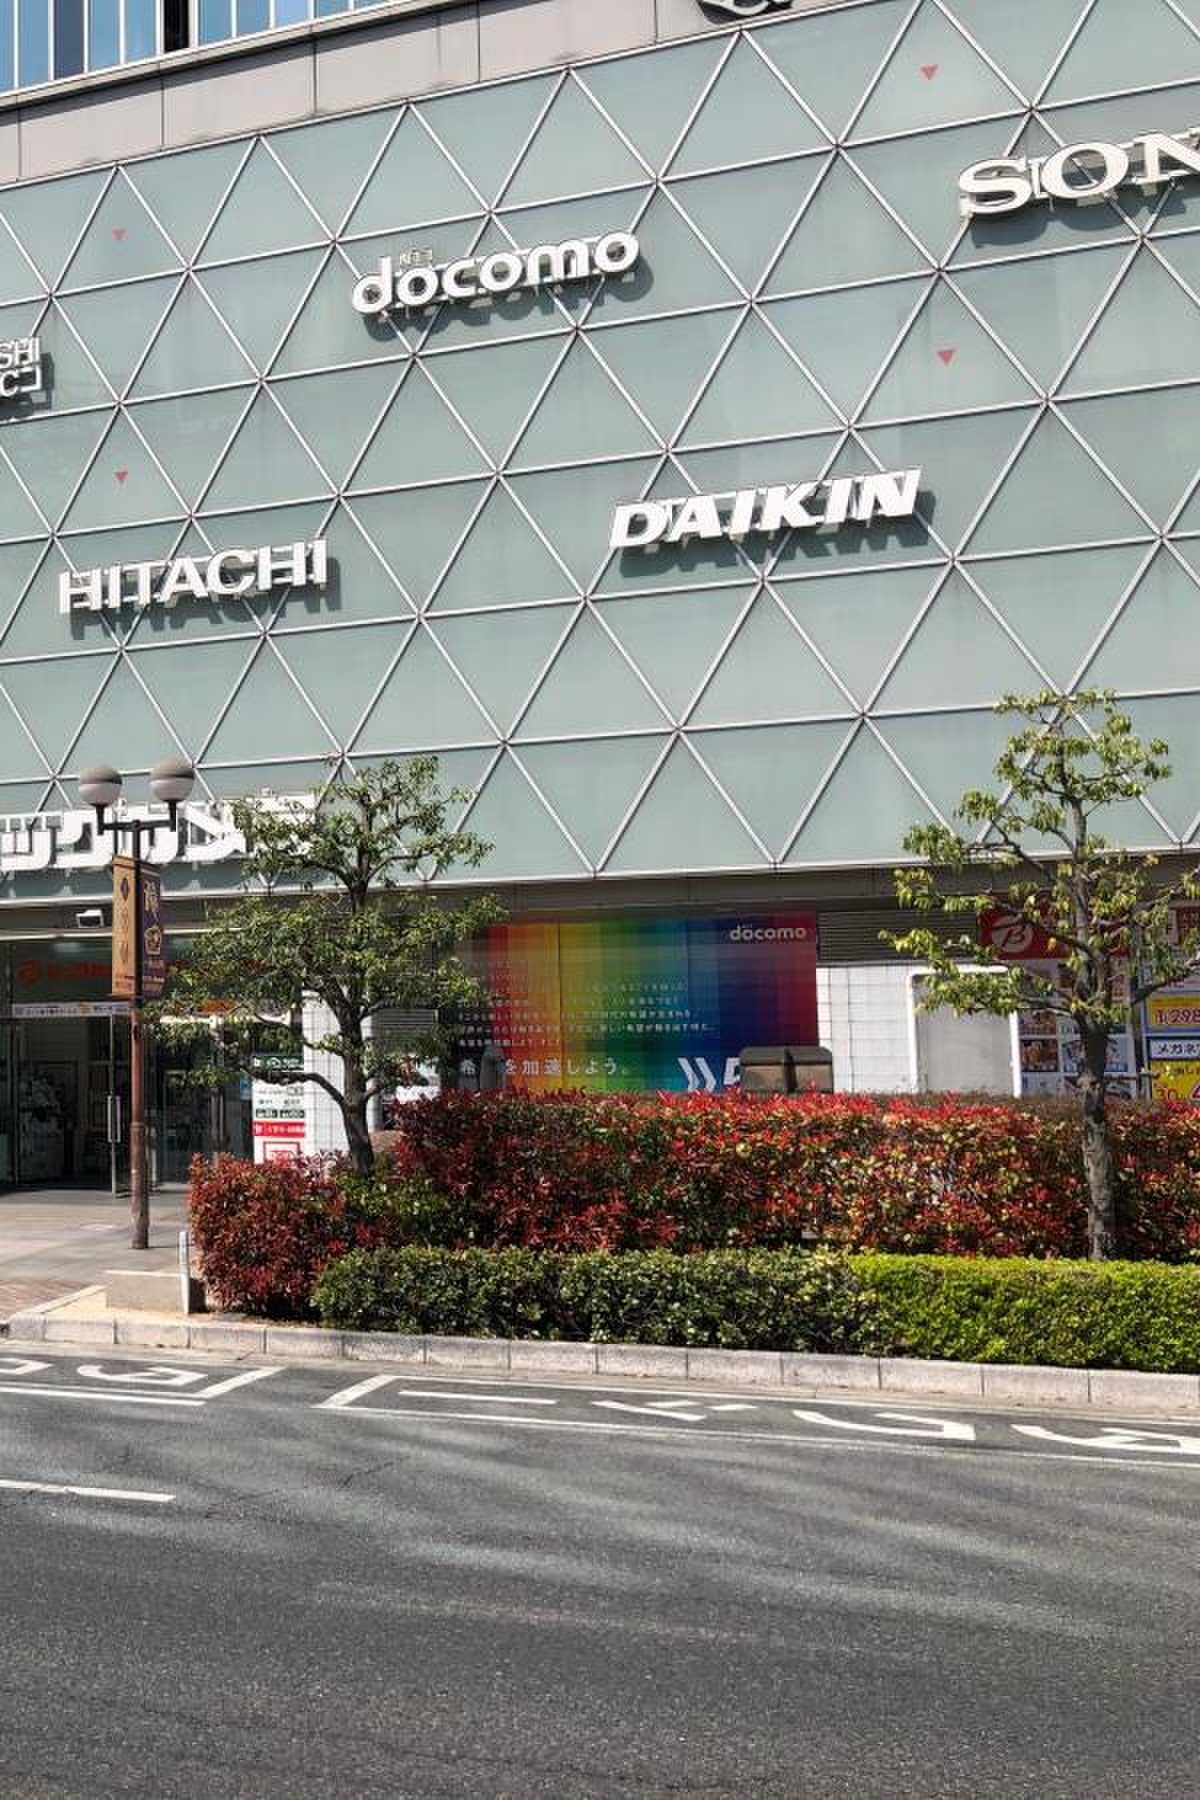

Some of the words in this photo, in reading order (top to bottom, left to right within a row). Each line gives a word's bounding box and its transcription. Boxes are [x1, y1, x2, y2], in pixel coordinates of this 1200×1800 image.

[351, 232, 639, 314] docomo
[609, 468, 922, 548] DAIKIN
[58, 539, 328, 614] HITACHI
[729, 925, 807, 943] docomo
[459, 1056, 630, 1076] 希を加速しよう。
